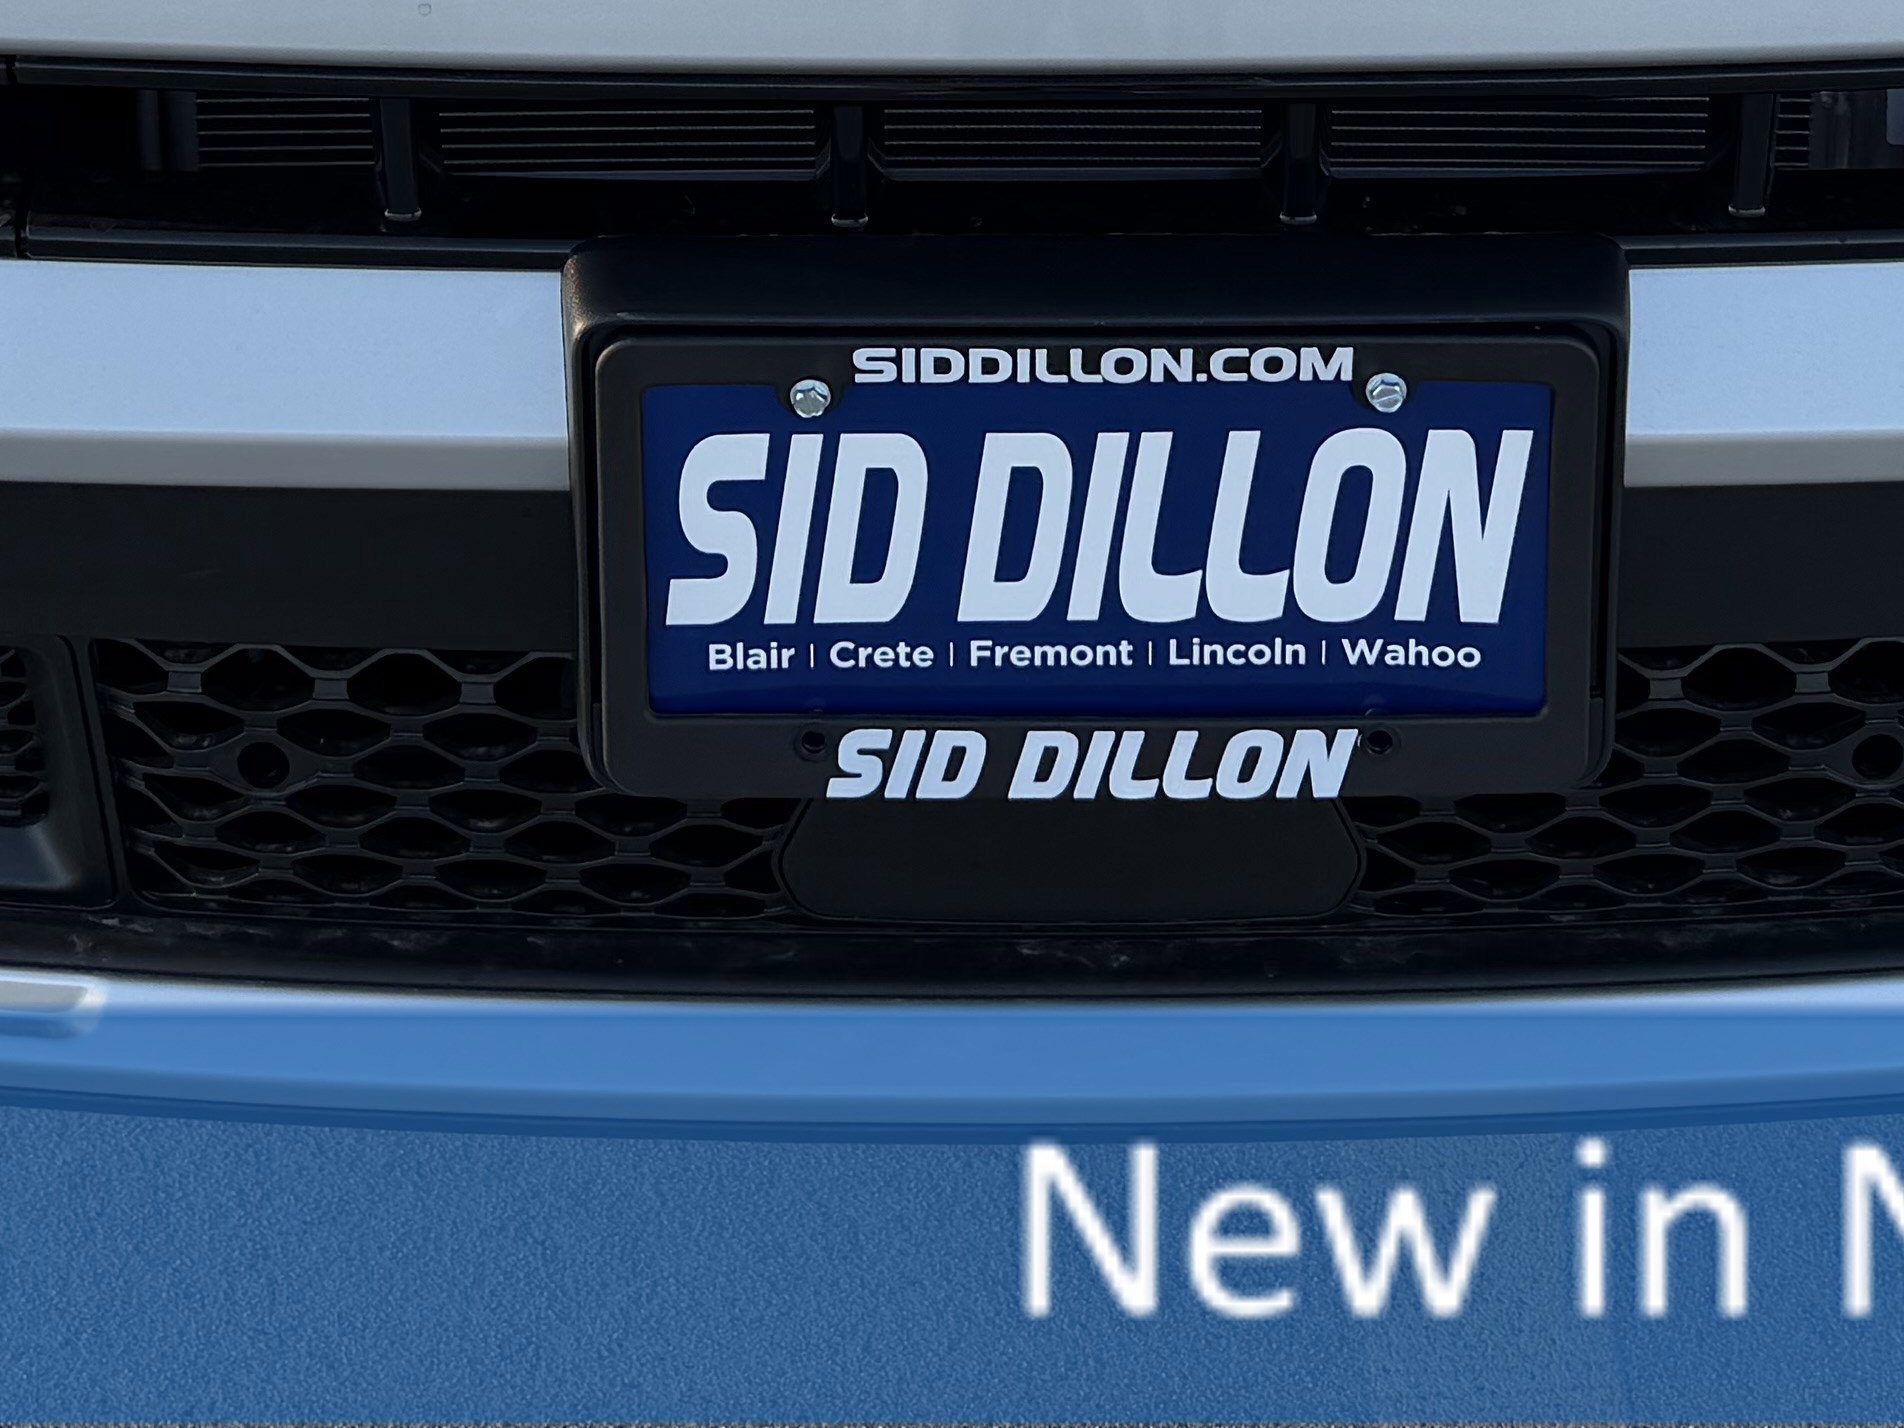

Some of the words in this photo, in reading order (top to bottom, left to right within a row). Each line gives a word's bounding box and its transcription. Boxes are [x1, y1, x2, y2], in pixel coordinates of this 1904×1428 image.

[852, 346, 1354, 384] SIDDILLON.COM
[665, 432, 929, 626] SID
[957, 427, 1534, 624] DILLON
[708, 641, 796, 671] Blair
[829, 641, 934, 668] Crete
[970, 640, 1134, 667] Fremont
[1169, 637, 1306, 666] Lincoln
[1341, 638, 1482, 668] Wahoo
[826, 728, 988, 799] SID
[1007, 728, 1360, 800] DILLON
